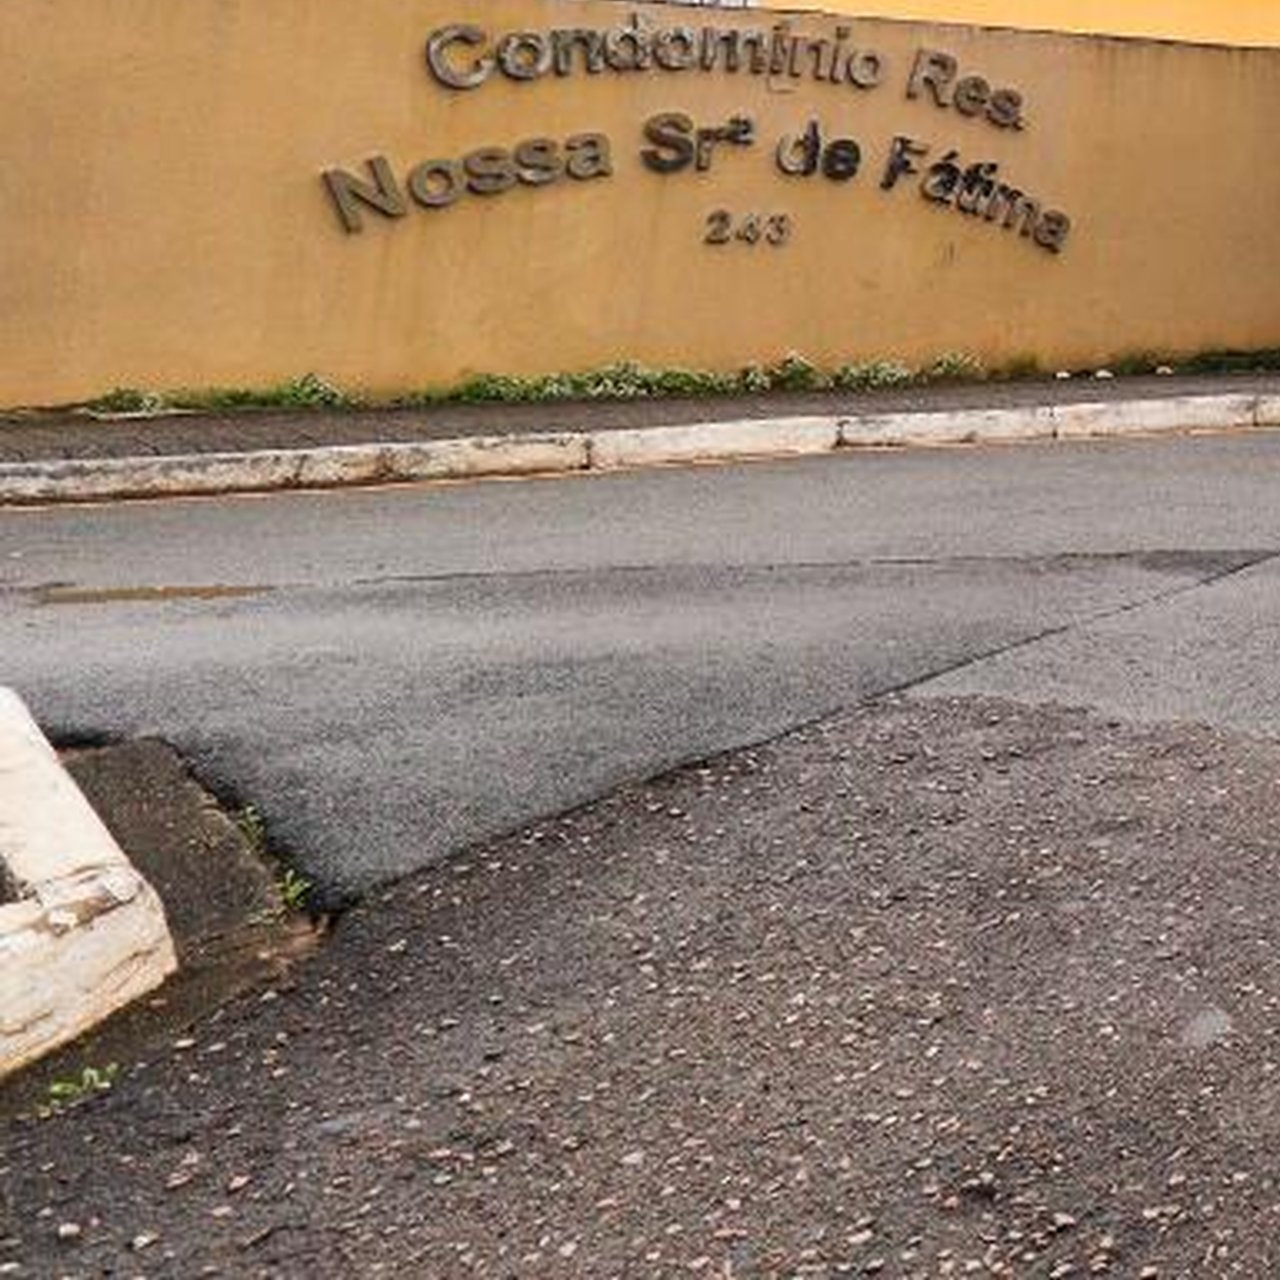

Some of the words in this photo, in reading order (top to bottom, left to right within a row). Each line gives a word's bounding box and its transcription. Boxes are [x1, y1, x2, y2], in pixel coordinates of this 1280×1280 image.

[322, 132, 613, 233] Nossa
[776, 119, 860, 180] de
[880, 136, 1071, 254] Fátima
